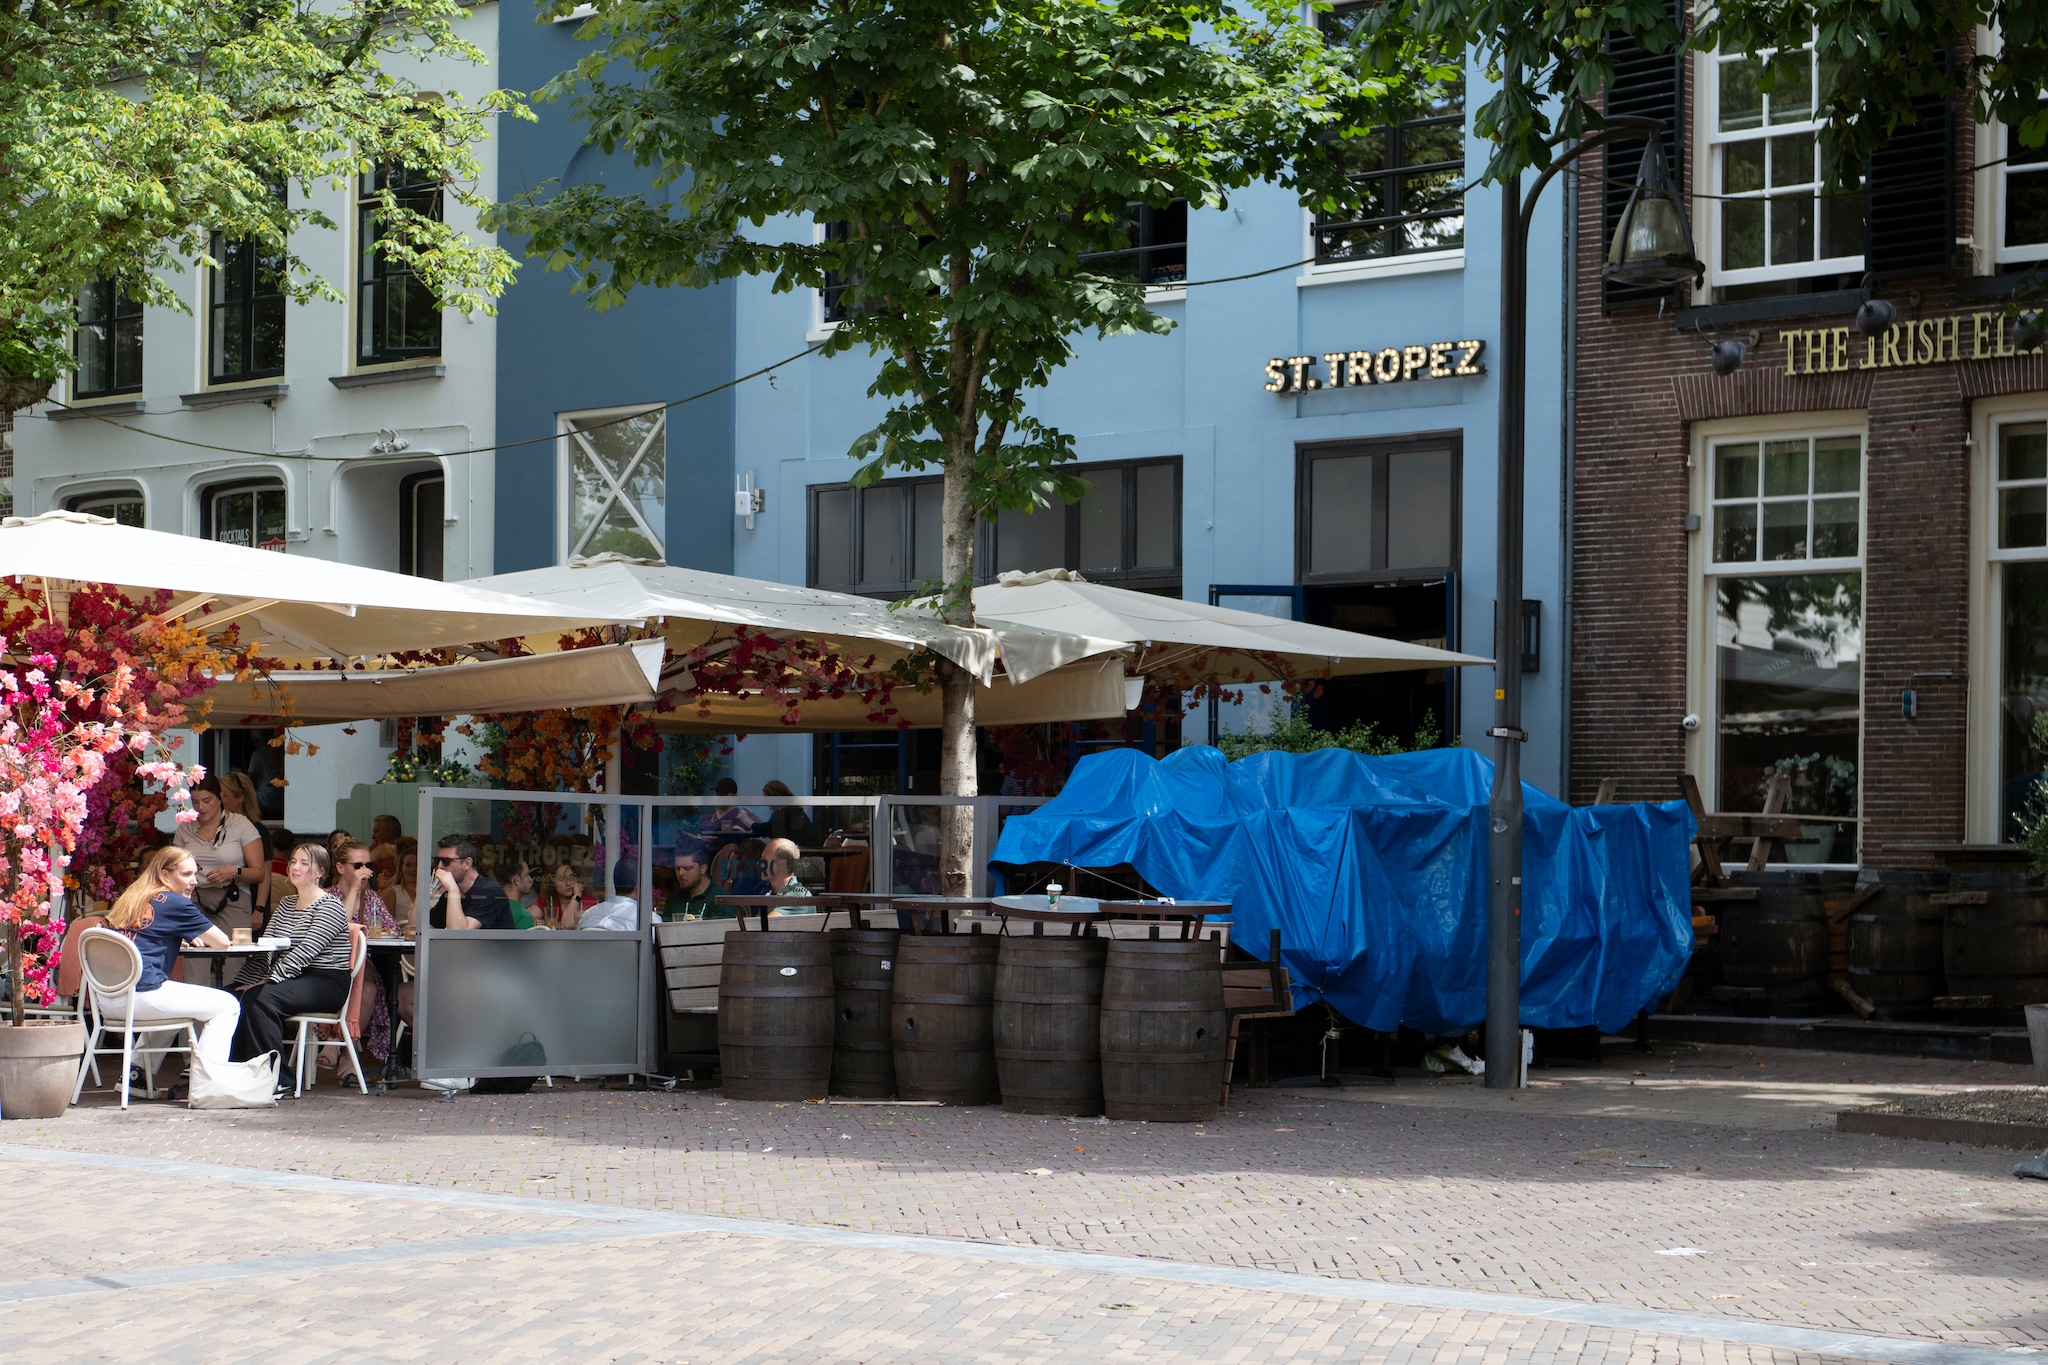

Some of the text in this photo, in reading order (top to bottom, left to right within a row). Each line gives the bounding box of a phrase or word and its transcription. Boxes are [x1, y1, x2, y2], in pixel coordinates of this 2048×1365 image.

[1779, 308, 2045, 376] THE IRISH EL
[1323, 339, 1486, 388] TROPEZ
[219, 528, 249, 543] COCKTAILS
[515, 844, 596, 868] TROPEZ
